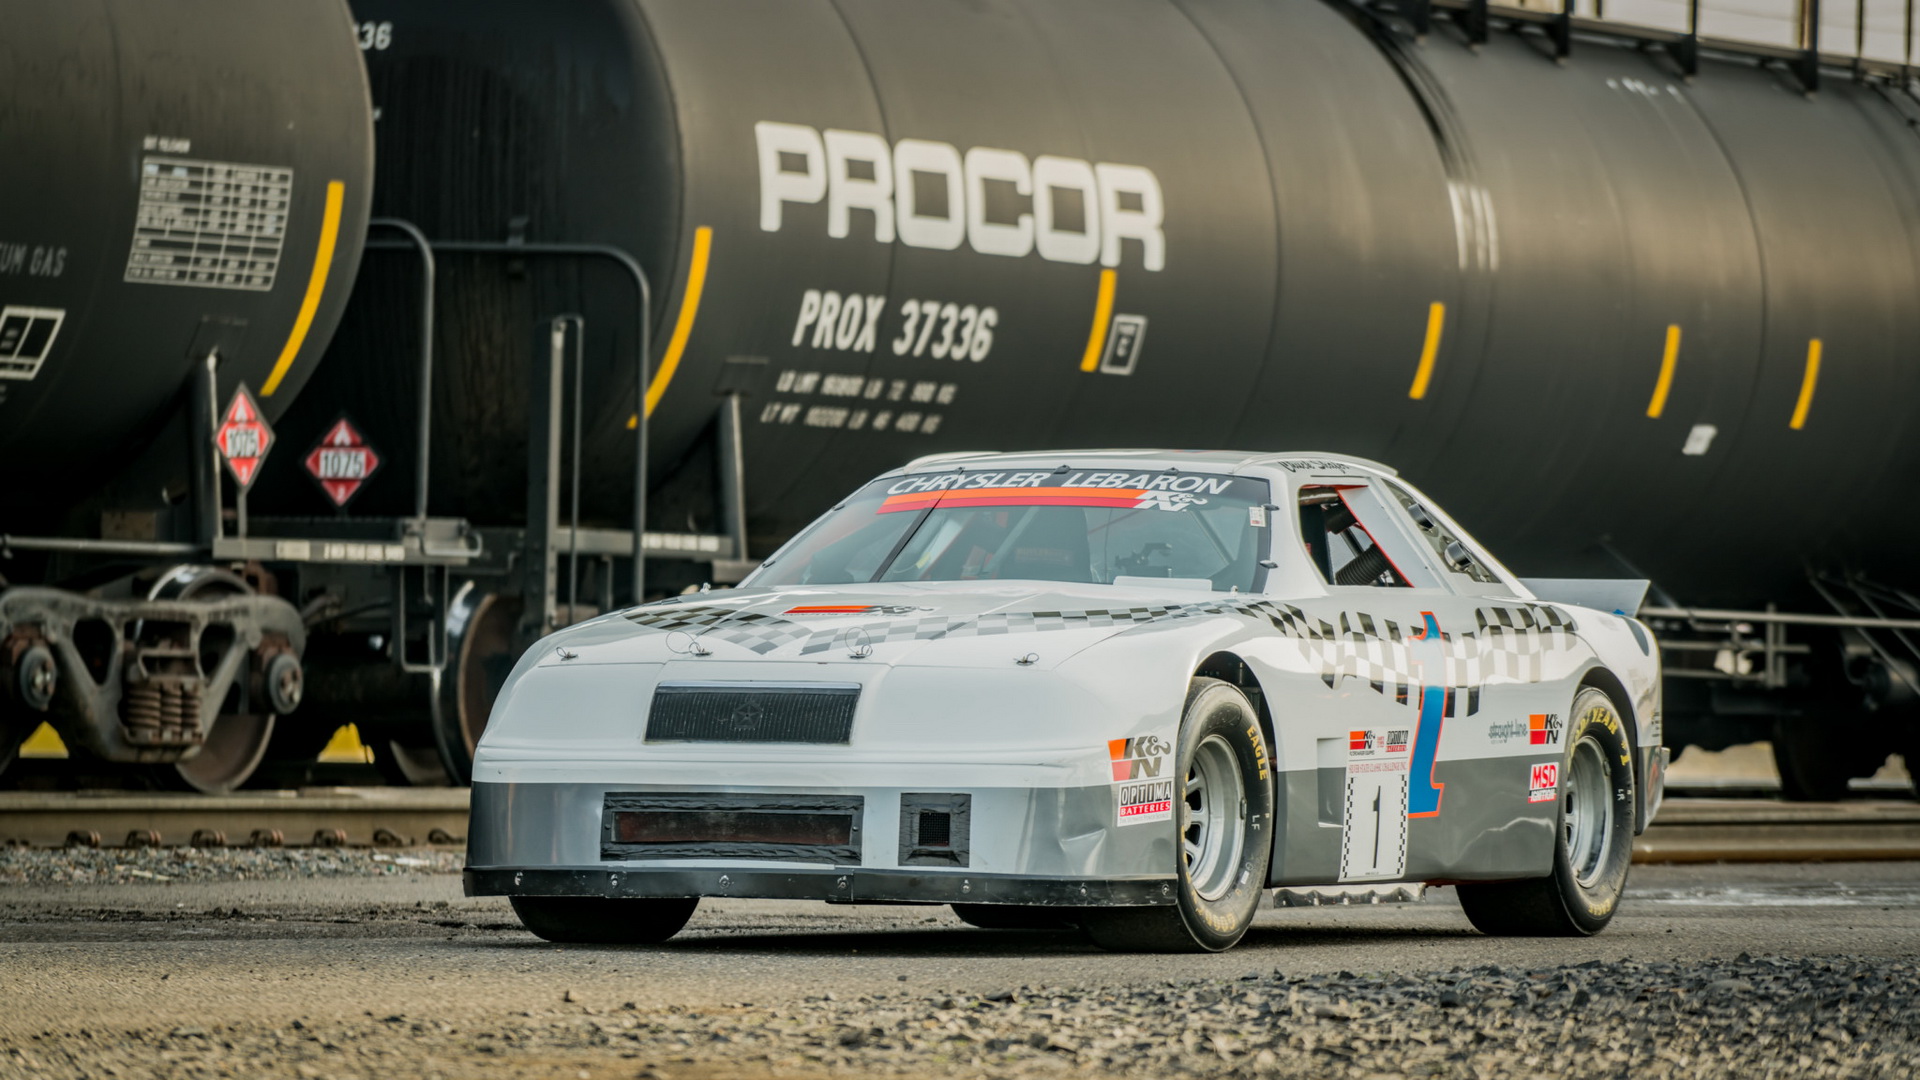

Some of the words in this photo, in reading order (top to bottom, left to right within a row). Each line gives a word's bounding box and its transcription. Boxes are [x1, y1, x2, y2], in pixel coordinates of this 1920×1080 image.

[353, 22, 393, 51] 36
[755, 120, 1166, 272] PROCOR
[29, 246, 68, 278] GAS
[791, 289, 886, 353] PROX
[892, 298, 998, 363] 37336
[228, 429, 258, 458] 1075
[322, 452, 363, 477] 1075
[887, 472, 1052, 496] CHRYSLER
[1060, 472, 1234, 495] LEBARON
[1407, 611, 1448, 819] 1
[1544, 713, 1563, 745] K&N
[1123, 735, 1172, 778] K&N
[1246, 725, 1269, 781] EAGLE
[1531, 764, 1557, 789] MSD
[1120, 801, 1171, 816] BATTERIES
[1121, 781, 1172, 806] OPTIMA
[1251, 814, 1261, 831] LF
[1372, 785, 1381, 869] 1
